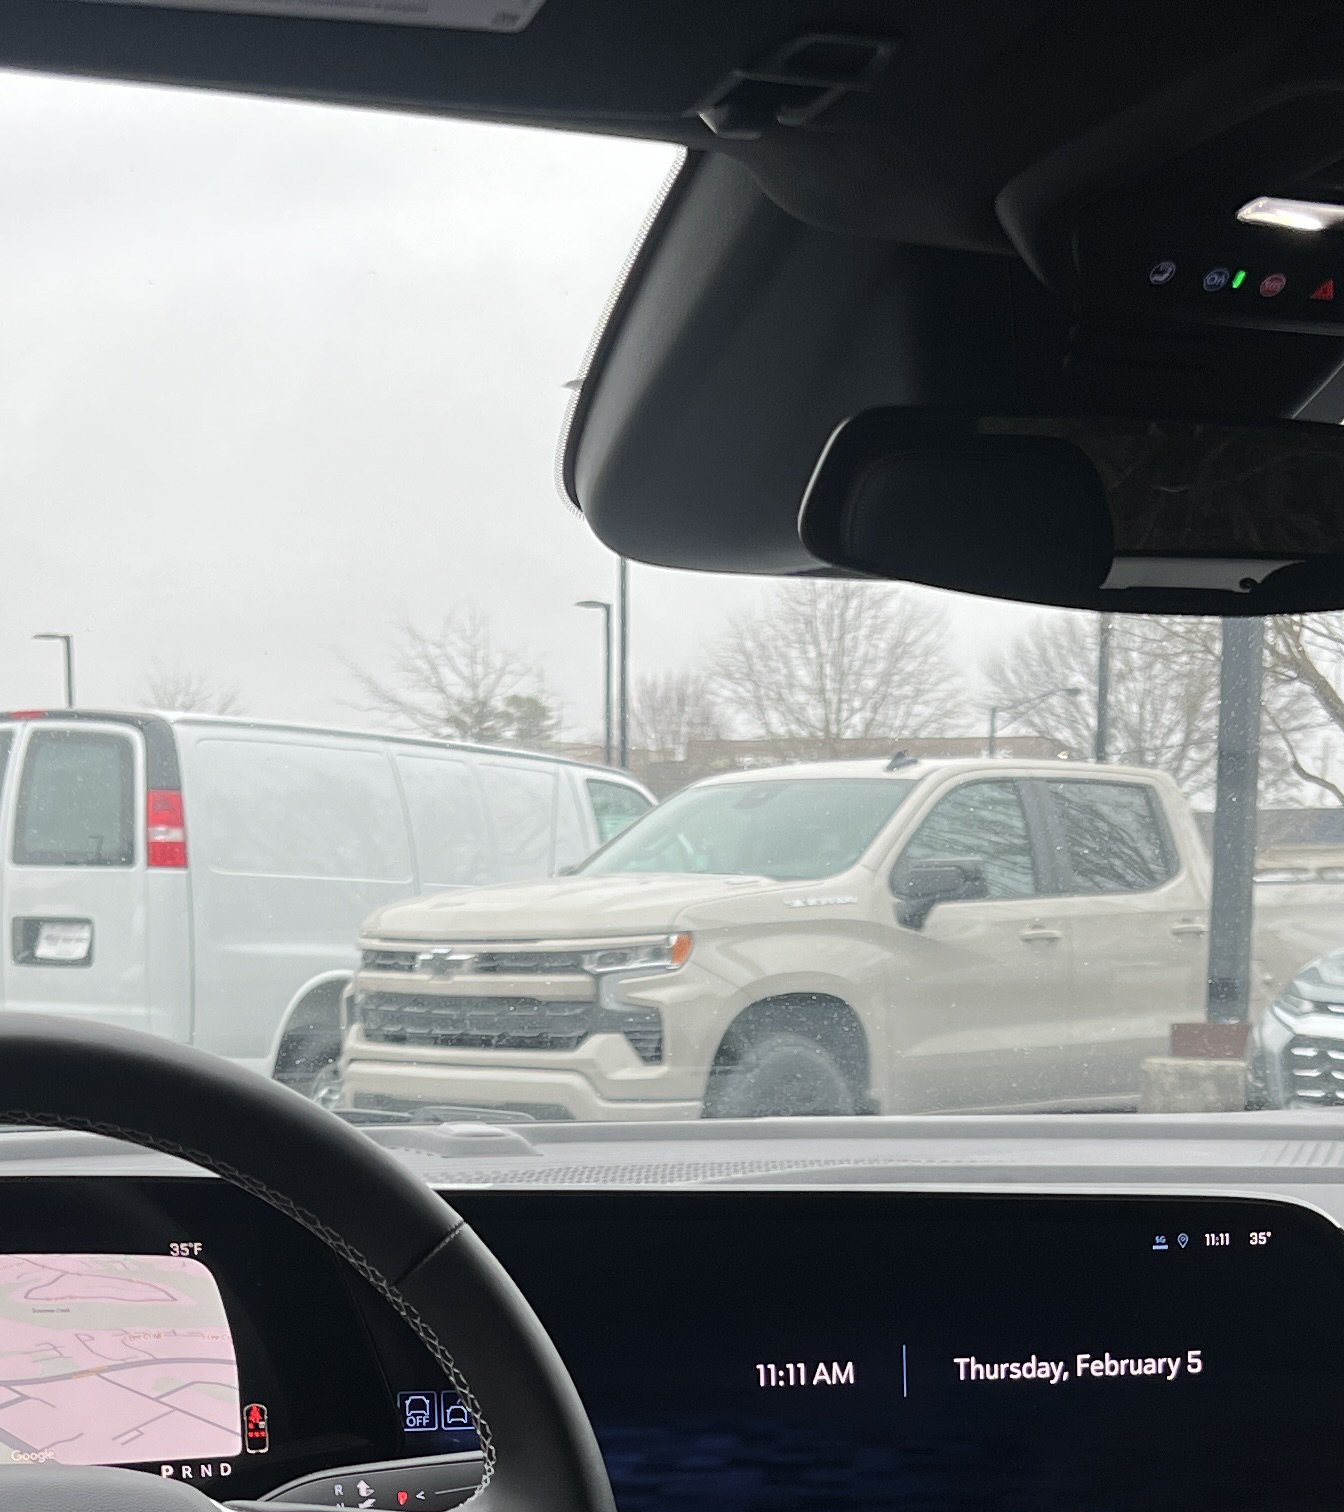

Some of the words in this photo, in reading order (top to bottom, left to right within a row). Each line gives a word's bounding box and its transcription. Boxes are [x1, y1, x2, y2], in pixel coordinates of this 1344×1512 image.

[1205, 1233, 1230, 1246] 11:11
[1249, 1231, 1272, 1245] 35°
[169, 1242, 203, 1257] 35°F
[756, 1363, 806, 1387] 11:11
[812, 1361, 855, 1385] AM
[953, 1354, 1069, 1385] Thursday,
[1076, 1352, 1181, 1381] February
[1186, 1350, 1203, 1374] 5
[406, 1416, 429, 1427] OFF
[10, 1449, 55, 1464] Google
[161, 1464, 175, 1479] P
[181, 1465, 193, 1479] R
[200, 1464, 212, 1477] N
[220, 1462, 232, 1476] D
[334, 1484, 344, 1496] R
[397, 1491, 408, 1505] P
